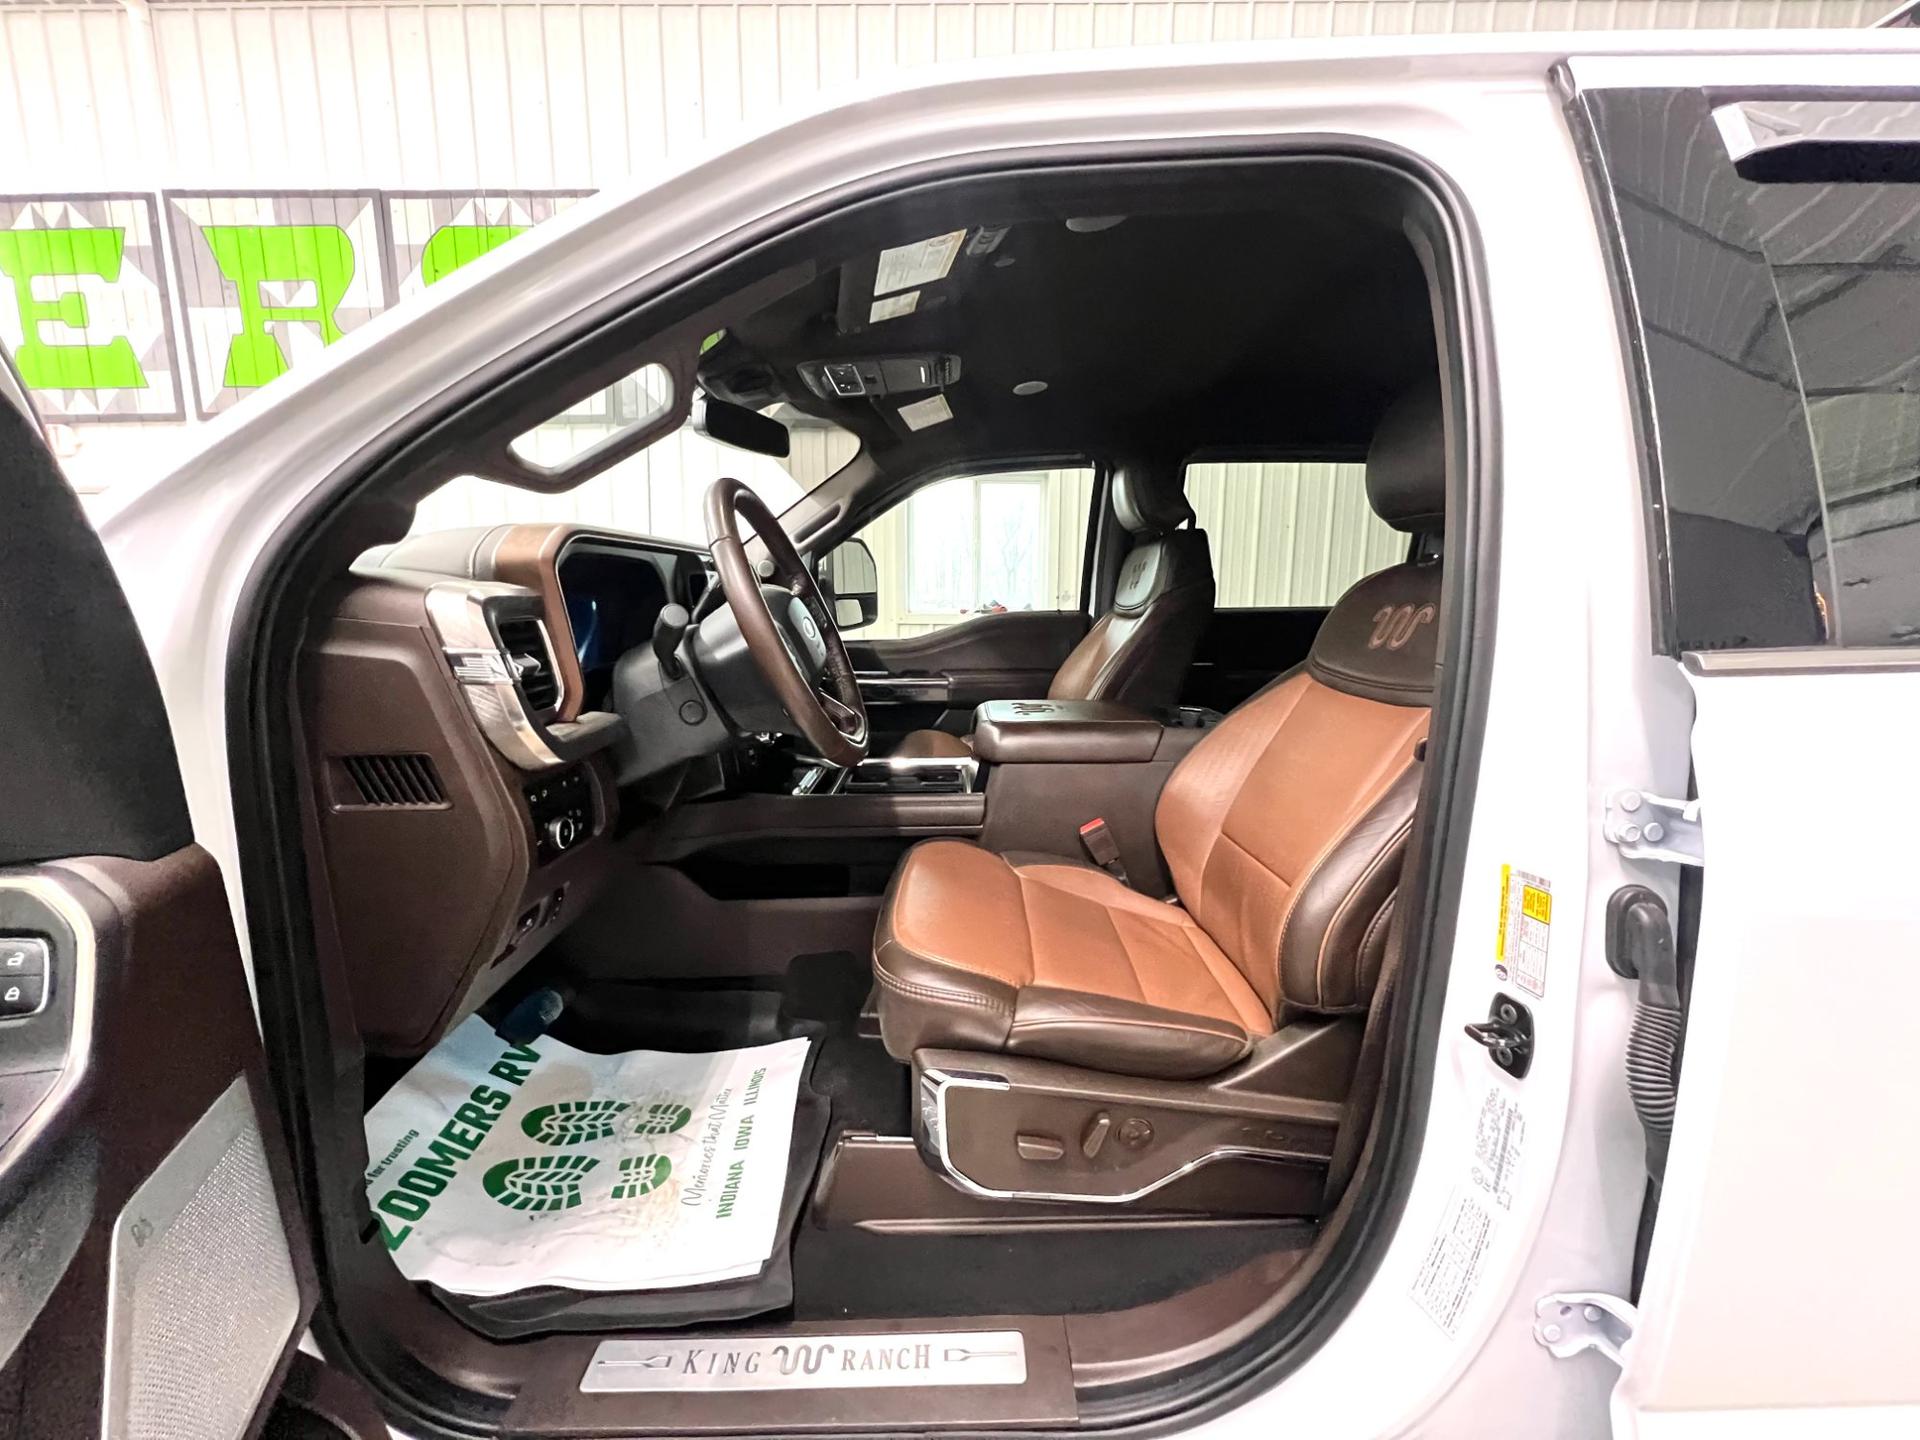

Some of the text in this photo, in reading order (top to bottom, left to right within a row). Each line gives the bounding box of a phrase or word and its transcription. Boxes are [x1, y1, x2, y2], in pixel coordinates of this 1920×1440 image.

[367, 1129, 420, 1178] for trusting
[371, 1044, 541, 1251] ZOOMERS RV
[716, 1067, 766, 1219] INDIANA IOWA ILLINOIS
[682, 1343, 931, 1376] KING RANCH
